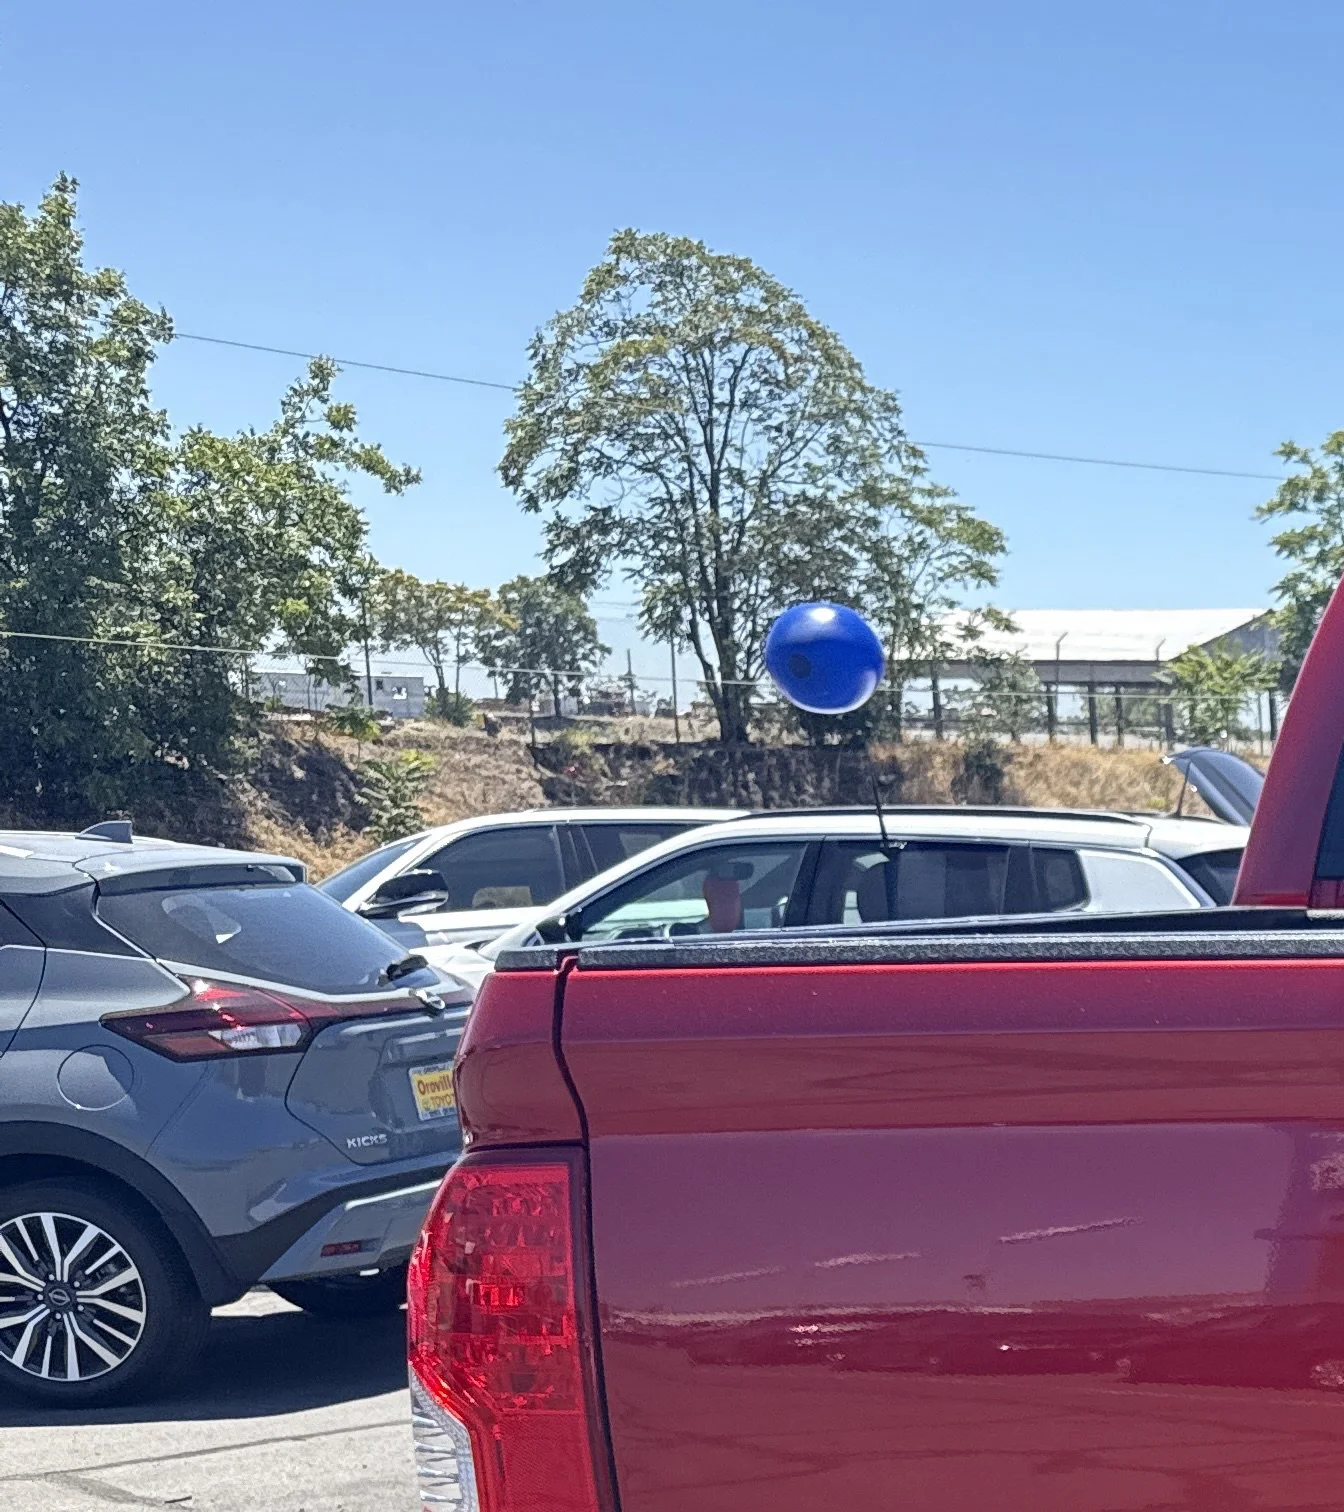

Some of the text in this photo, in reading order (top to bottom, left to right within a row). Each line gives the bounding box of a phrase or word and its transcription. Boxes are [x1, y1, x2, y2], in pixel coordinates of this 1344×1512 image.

[417, 1074, 453, 1096] Orovill
[430, 1092, 456, 1110] TOYO
[346, 1133, 388, 1149] KICKS
